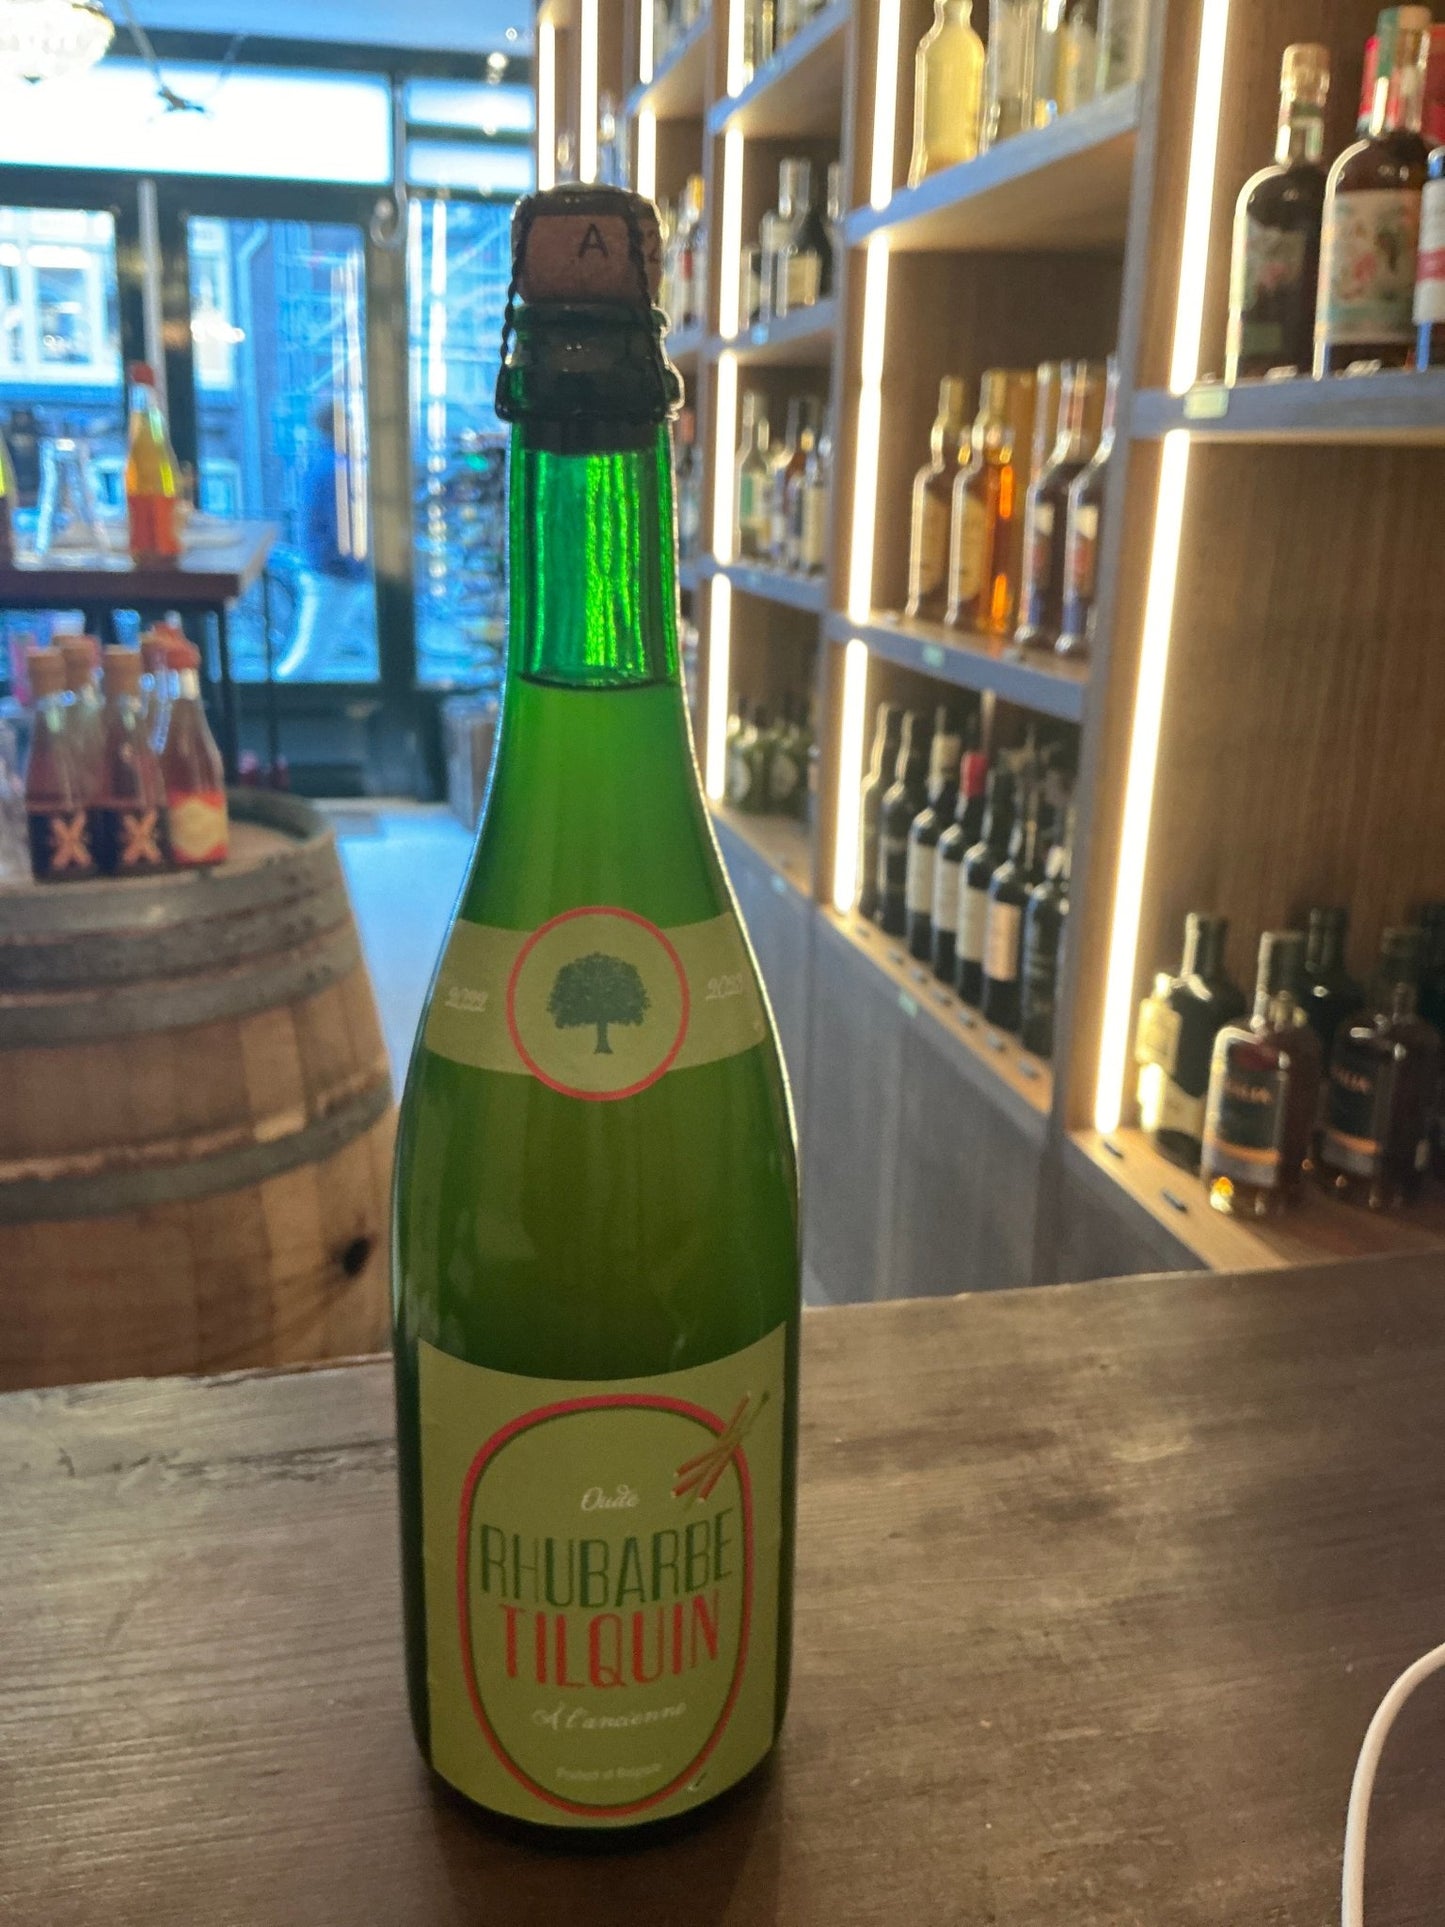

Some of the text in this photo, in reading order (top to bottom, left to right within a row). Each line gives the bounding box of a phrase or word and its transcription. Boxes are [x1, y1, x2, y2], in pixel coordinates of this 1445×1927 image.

[577, 222, 610, 259] A
[580, 1484, 642, 1512] Oude
[480, 1507, 733, 1609] RHUBARBE
[499, 1588, 720, 1690] TILQUIN
